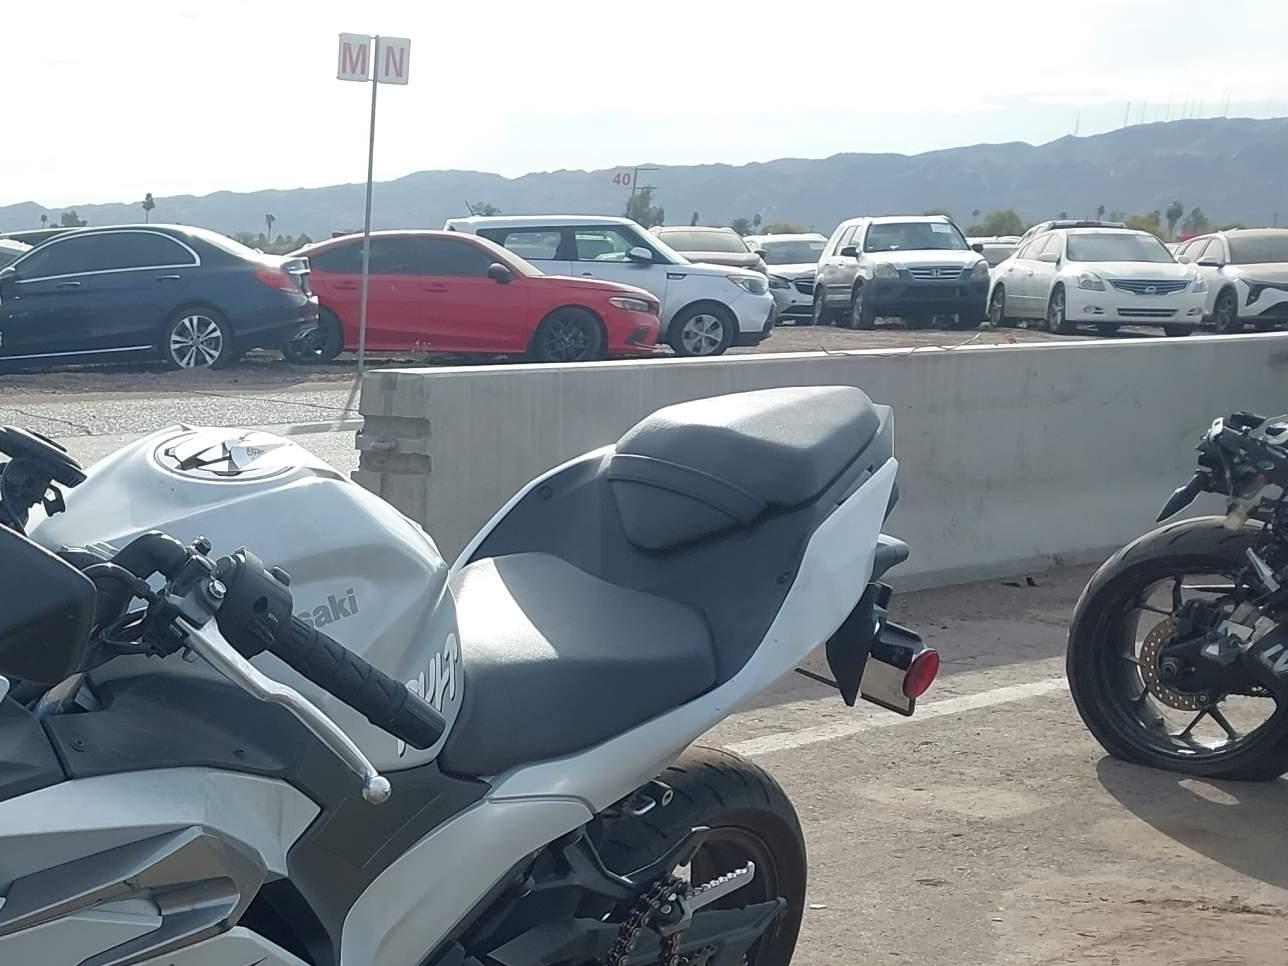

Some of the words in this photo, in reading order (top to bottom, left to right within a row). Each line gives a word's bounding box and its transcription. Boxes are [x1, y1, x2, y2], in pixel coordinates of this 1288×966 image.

[342, 42, 368, 75] M
[385, 46, 405, 78] N
[612, 173, 631, 186] 40
[296, 587, 359, 628] saki
